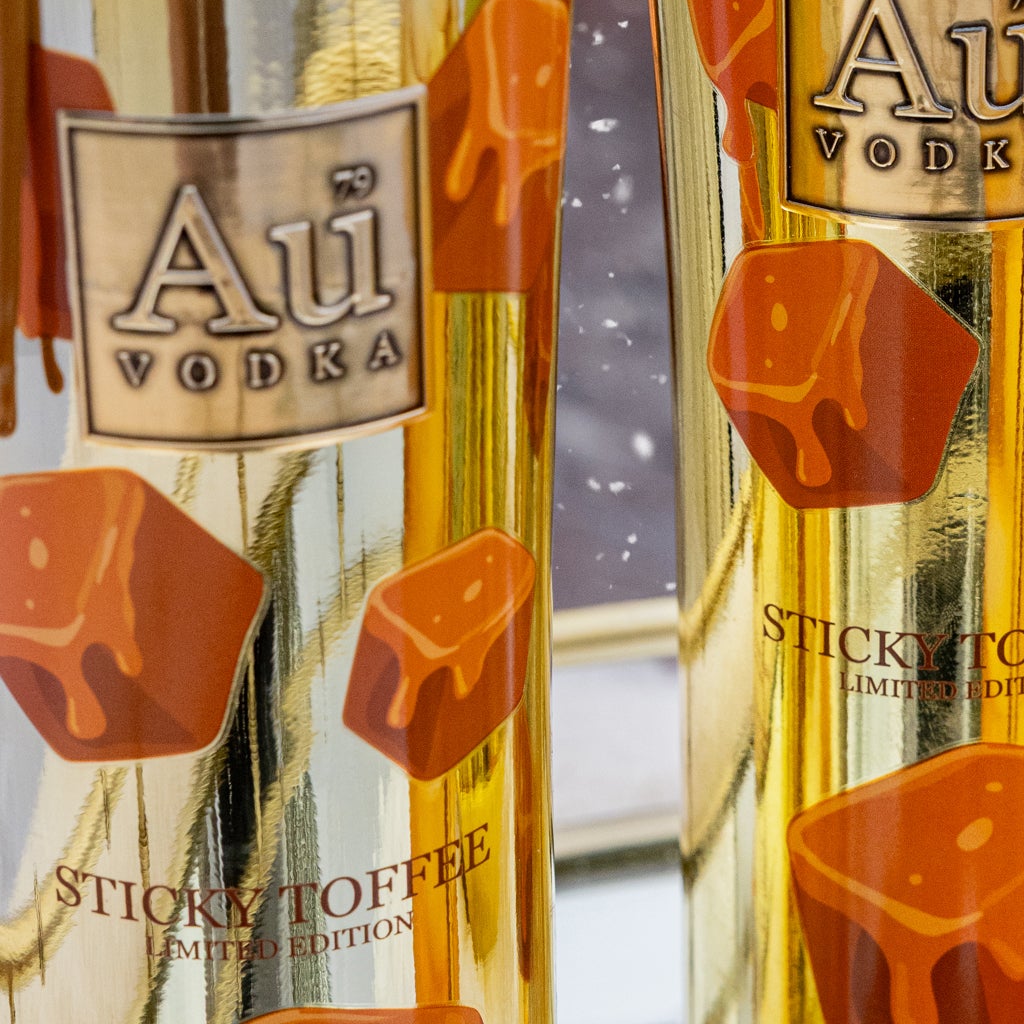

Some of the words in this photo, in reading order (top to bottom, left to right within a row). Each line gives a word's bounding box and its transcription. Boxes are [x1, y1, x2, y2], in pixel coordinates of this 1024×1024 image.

[332, 166, 373, 200] 79
[113, 184, 391, 334] Au
[118, 332, 401, 390] VODKA
[763, 603, 949, 670] STICKY
[839, 672, 957, 700] LIMITED
[55, 865, 262, 929] STICKY
[279, 823, 490, 923] TOFFEE
[147, 935, 278, 961] LIMITED
[289, 911, 413, 957] EDITION
